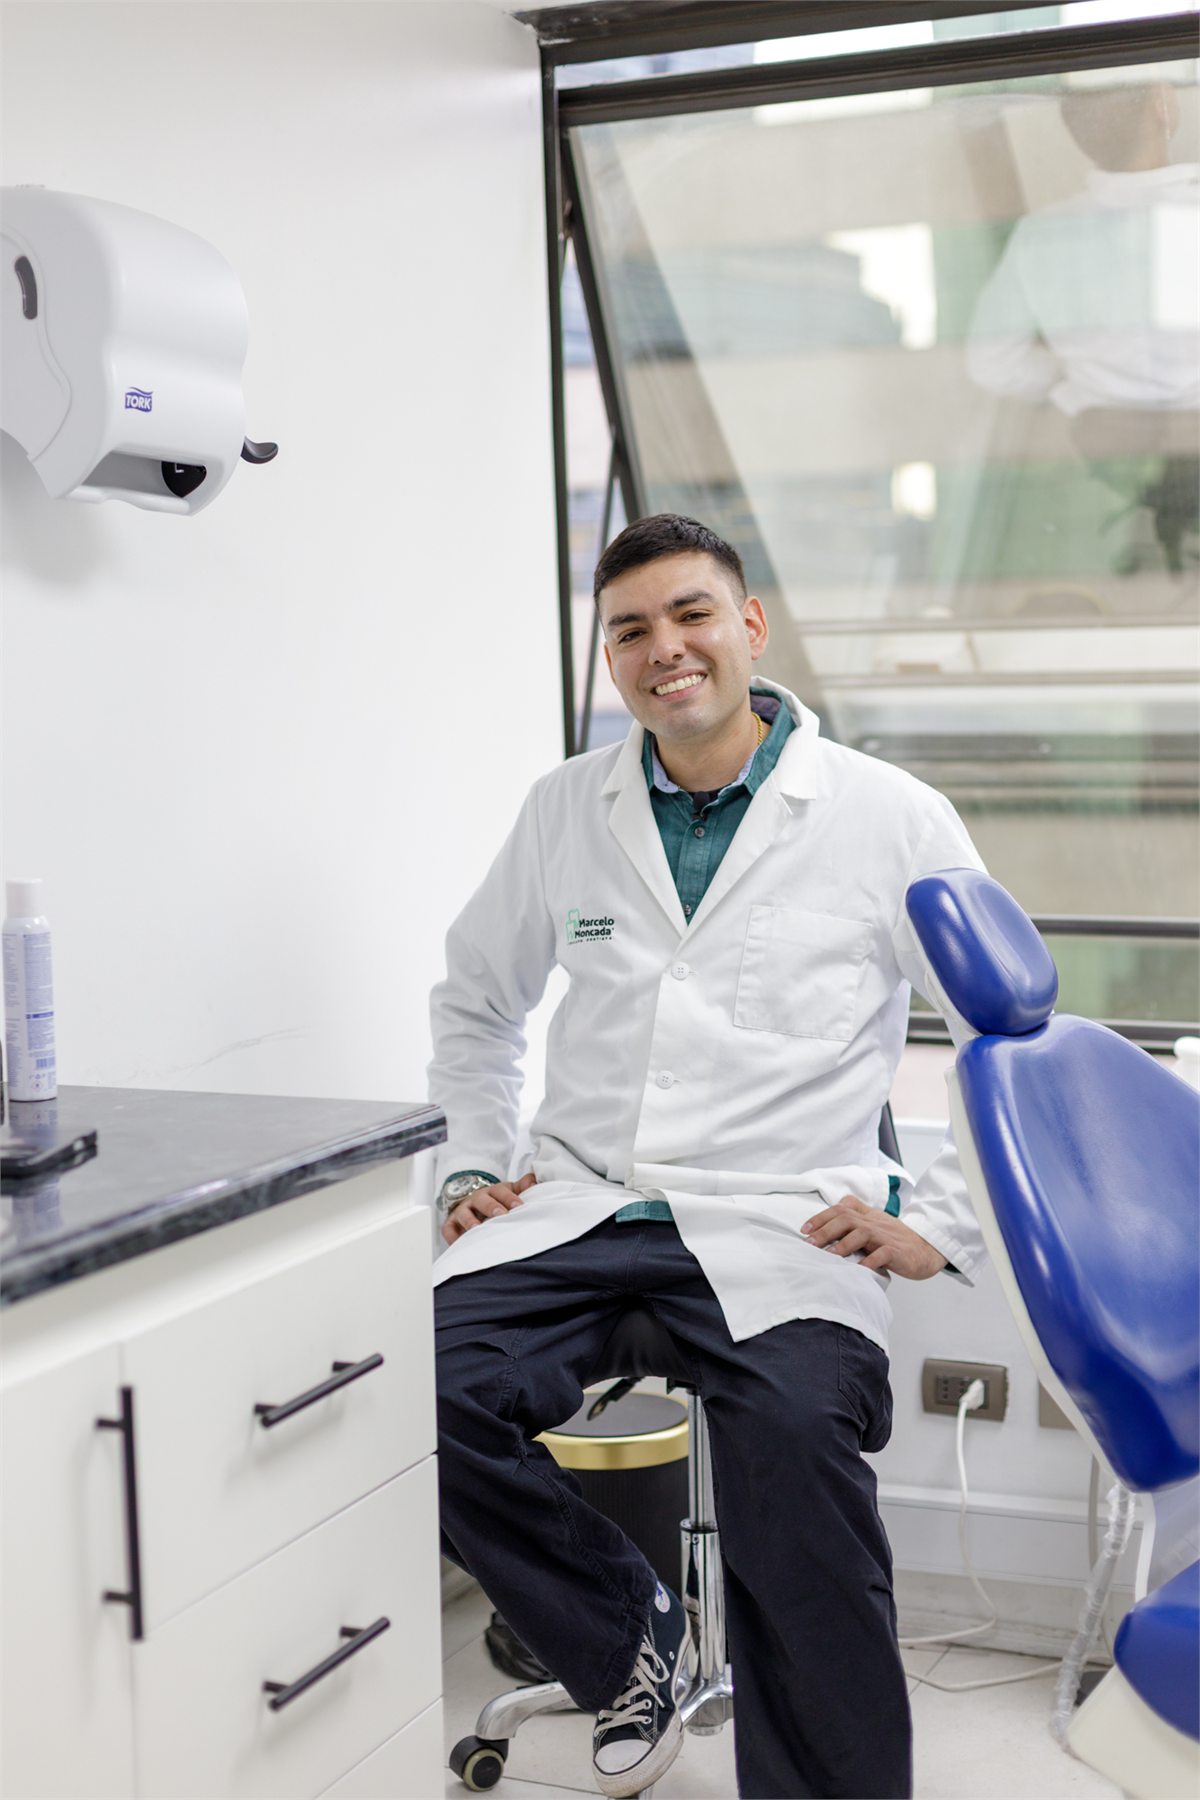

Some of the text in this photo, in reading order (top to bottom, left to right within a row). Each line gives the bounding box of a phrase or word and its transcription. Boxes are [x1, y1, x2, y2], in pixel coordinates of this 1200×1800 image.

[126, 394, 151, 410] TORK
[579, 916, 615, 928] Marcelo
[574, 927, 612, 939] Moncada
